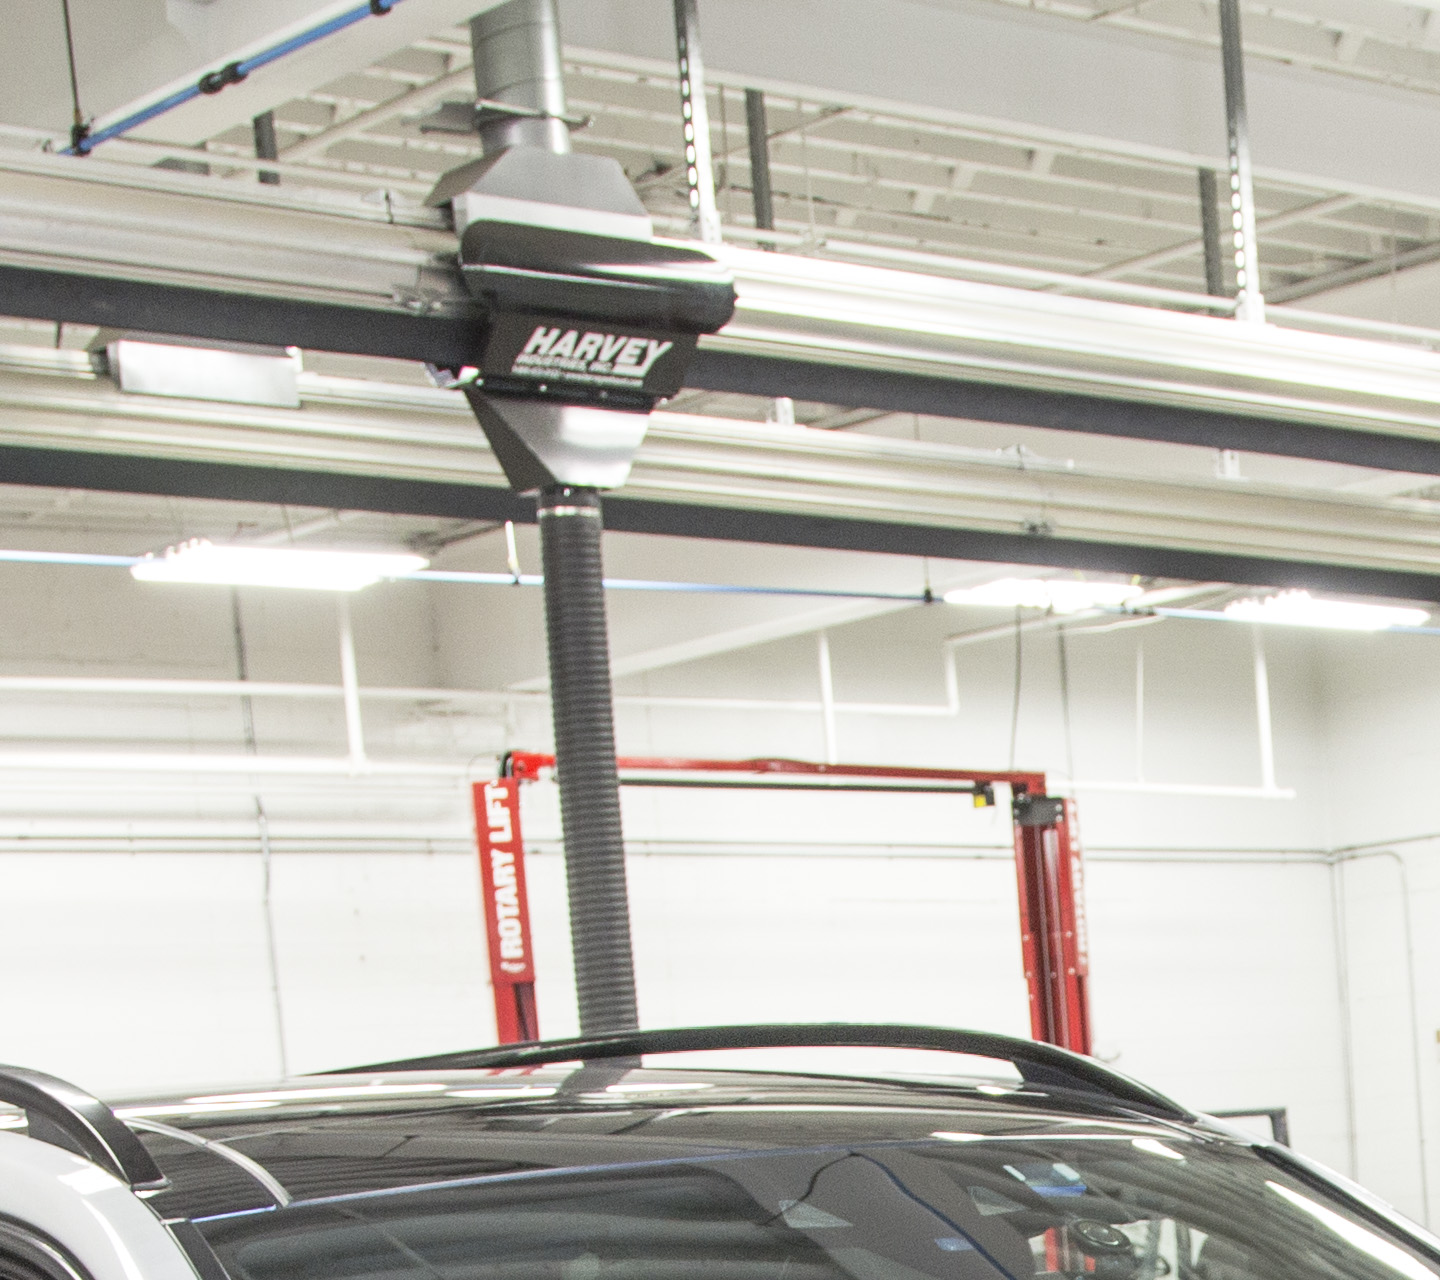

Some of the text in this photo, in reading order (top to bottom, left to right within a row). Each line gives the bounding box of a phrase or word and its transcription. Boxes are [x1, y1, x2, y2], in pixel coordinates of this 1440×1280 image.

[523, 325, 673, 370] HARVEY
[484, 784, 524, 959] ROTARY LIFT
